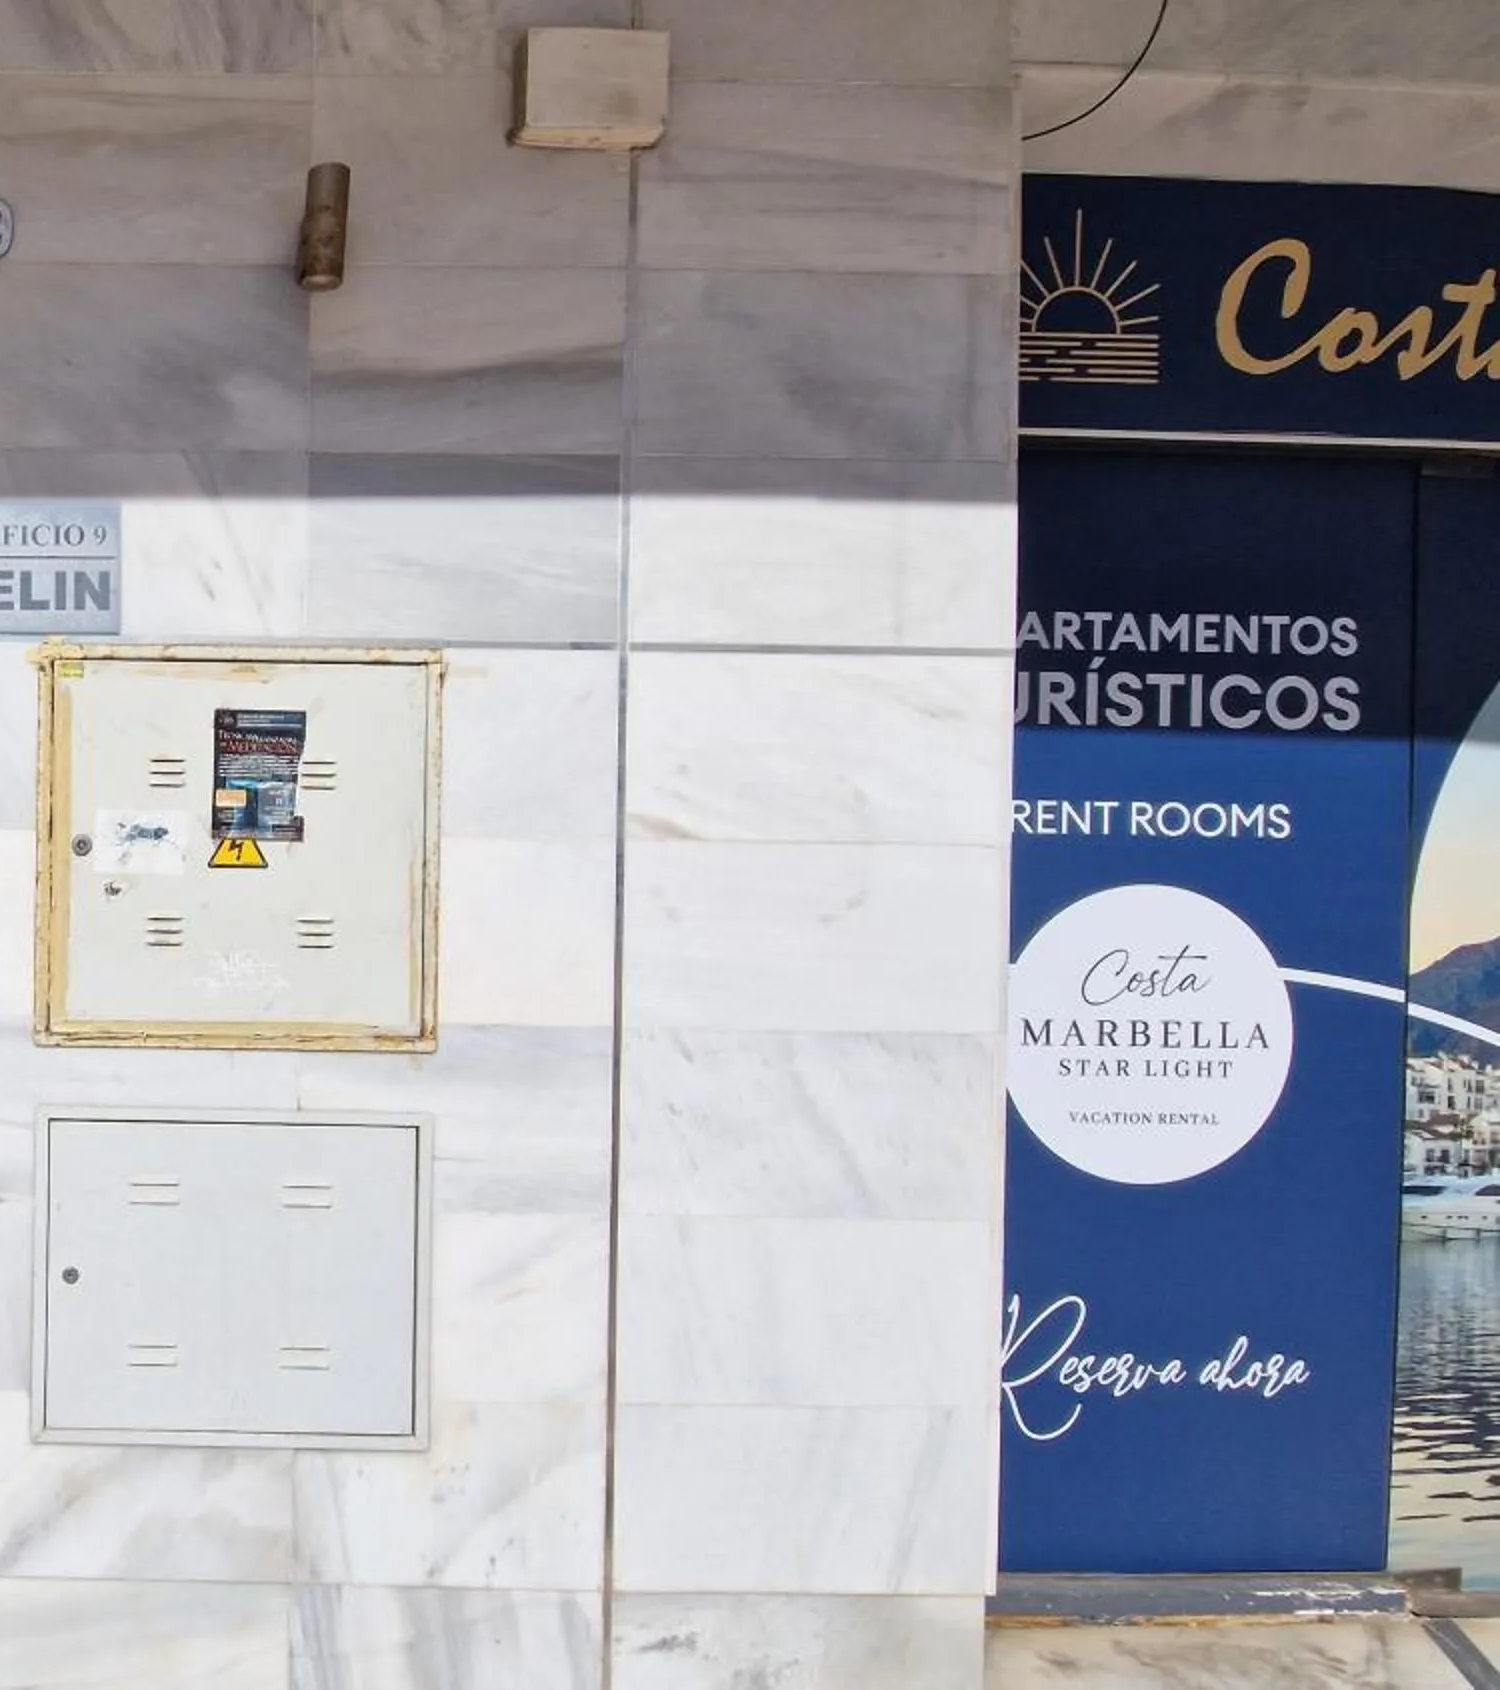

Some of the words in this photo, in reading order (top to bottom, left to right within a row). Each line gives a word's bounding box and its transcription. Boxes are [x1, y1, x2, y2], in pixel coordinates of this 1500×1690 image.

[93, 524, 107, 545] 9
[1015, 610, 1359, 657] ARTAMENTOS
[1011, 799, 1120, 835] RENT
[1130, 801, 1292, 840] ROOMS
[1081, 944, 1209, 1006] Costa
[1020, 1018, 1269, 1049] MARBELLA
[1058, 1058, 1131, 1078] STAR
[1144, 1059, 1234, 1079] LIGHT
[1068, 1111, 1152, 1126] VACATION
[1157, 1112, 1220, 1126] RENTAL
[1000, 1294, 1187, 1441] Reserva
[1199, 1335, 1311, 1398] ahora
